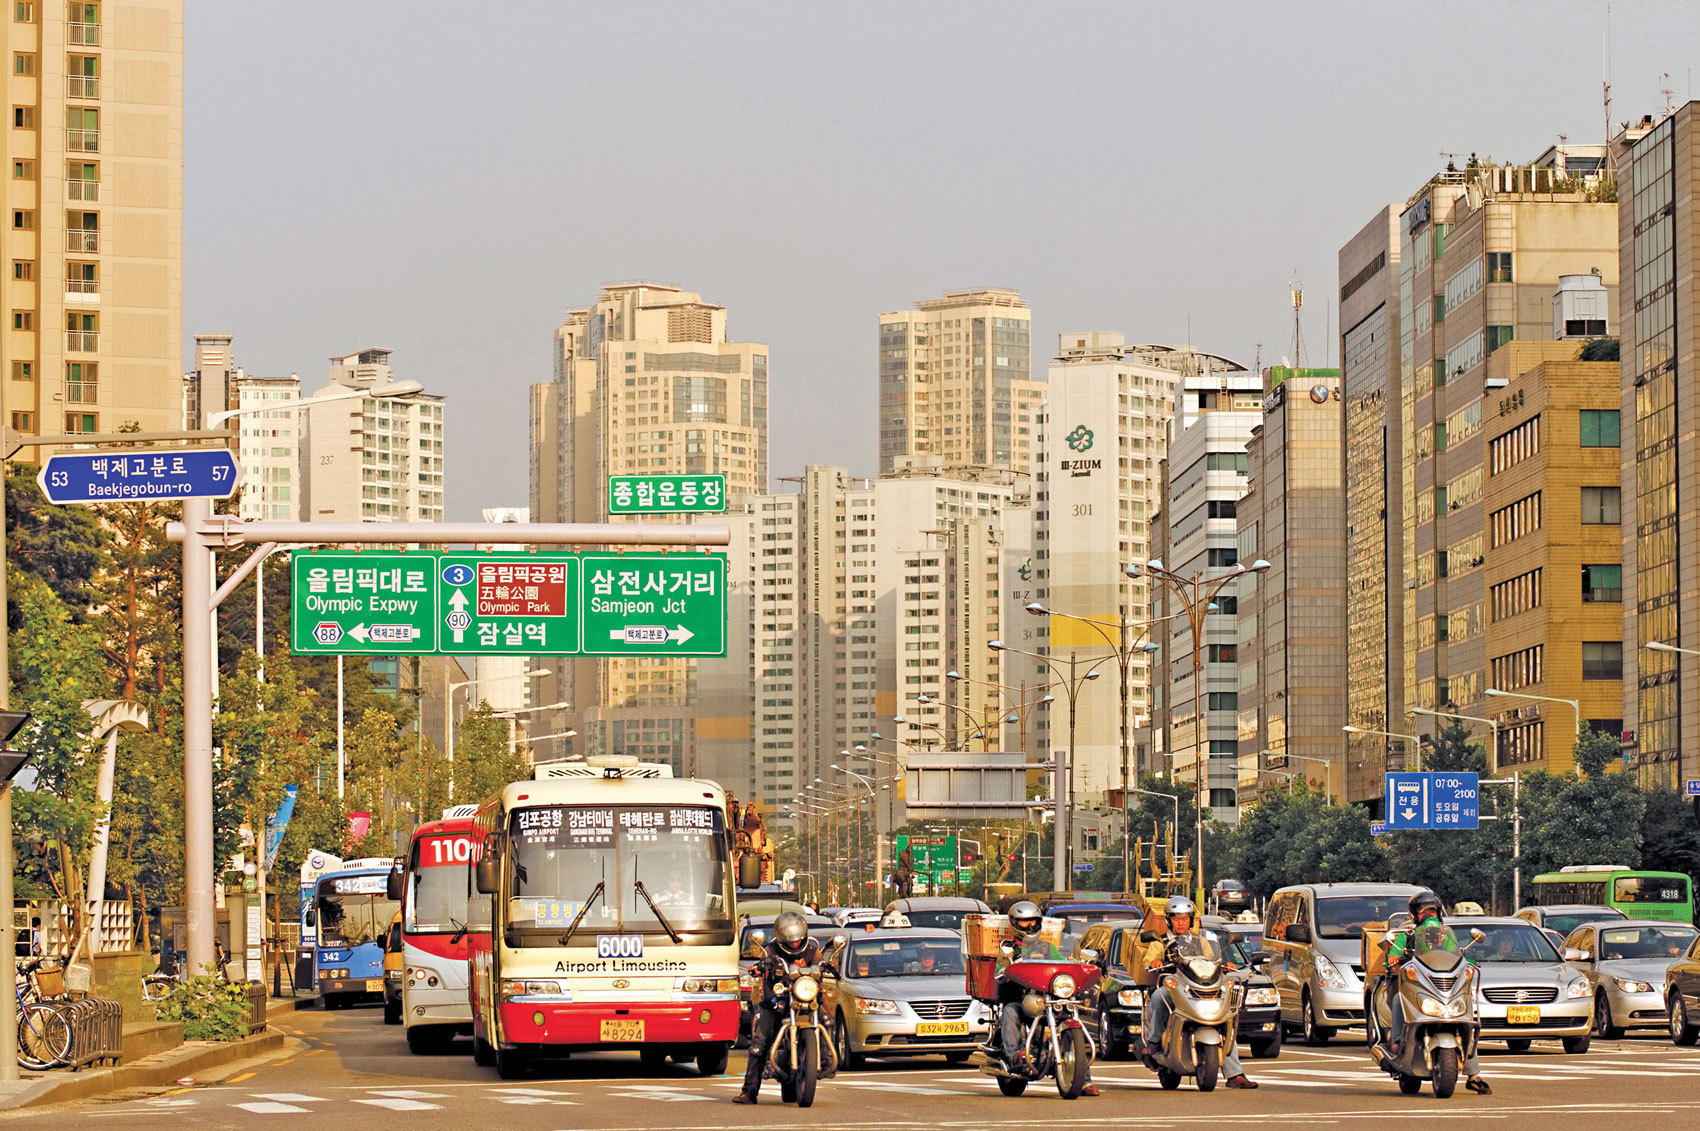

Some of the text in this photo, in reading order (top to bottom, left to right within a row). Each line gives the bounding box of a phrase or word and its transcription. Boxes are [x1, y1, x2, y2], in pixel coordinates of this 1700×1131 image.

[320, 455, 334, 465] 237
[92, 456, 188, 480] 백제고분로
[212, 465, 230, 481] 57
[51, 471, 68, 487] 53
[88, 480, 192, 498] Baekjegobun-ro
[613, 480, 721, 507] 종합운동장
[1072, 503, 1093, 517] 301
[306, 568, 428, 593] 올림픽대로
[453, 568, 464, 582] 3
[480, 566, 565, 583] 올림픽공원
[590, 570, 715, 596] 삼전사거리
[480, 586, 539, 600] 五輪公園
[306, 595, 418, 615] Olympic Expwy
[480, 601, 551, 614] Olympic Park
[591, 597, 686, 616] Samjeon Jct
[451, 614, 466, 627] 90
[320, 628, 337, 641] 88
[373, 628, 410, 639] 백제고분로
[477, 622, 546, 646] 잠실역
[627, 629, 663, 640] 백제고분로
[1454, 790, 1476, 799] 21:00
[1435, 802, 1459, 812] 토요일
[519, 810, 563, 829] 김포공항
[569, 810, 614, 828] 강남터미널
[619, 811, 665, 827] 테헤란로
[1435, 813, 1459, 823] 공휴일
[539, 828, 559, 836] AIRPORT
[335, 879, 359, 893] 342
[1661, 889, 1679, 899] 4318
[600, 936, 641, 957] 6000
[323, 952, 339, 961] 342
[555, 960, 687, 973] Airport Limousine
[612, 1029, 643, 1040] 8294
[944, 1023, 965, 1033] 2963
